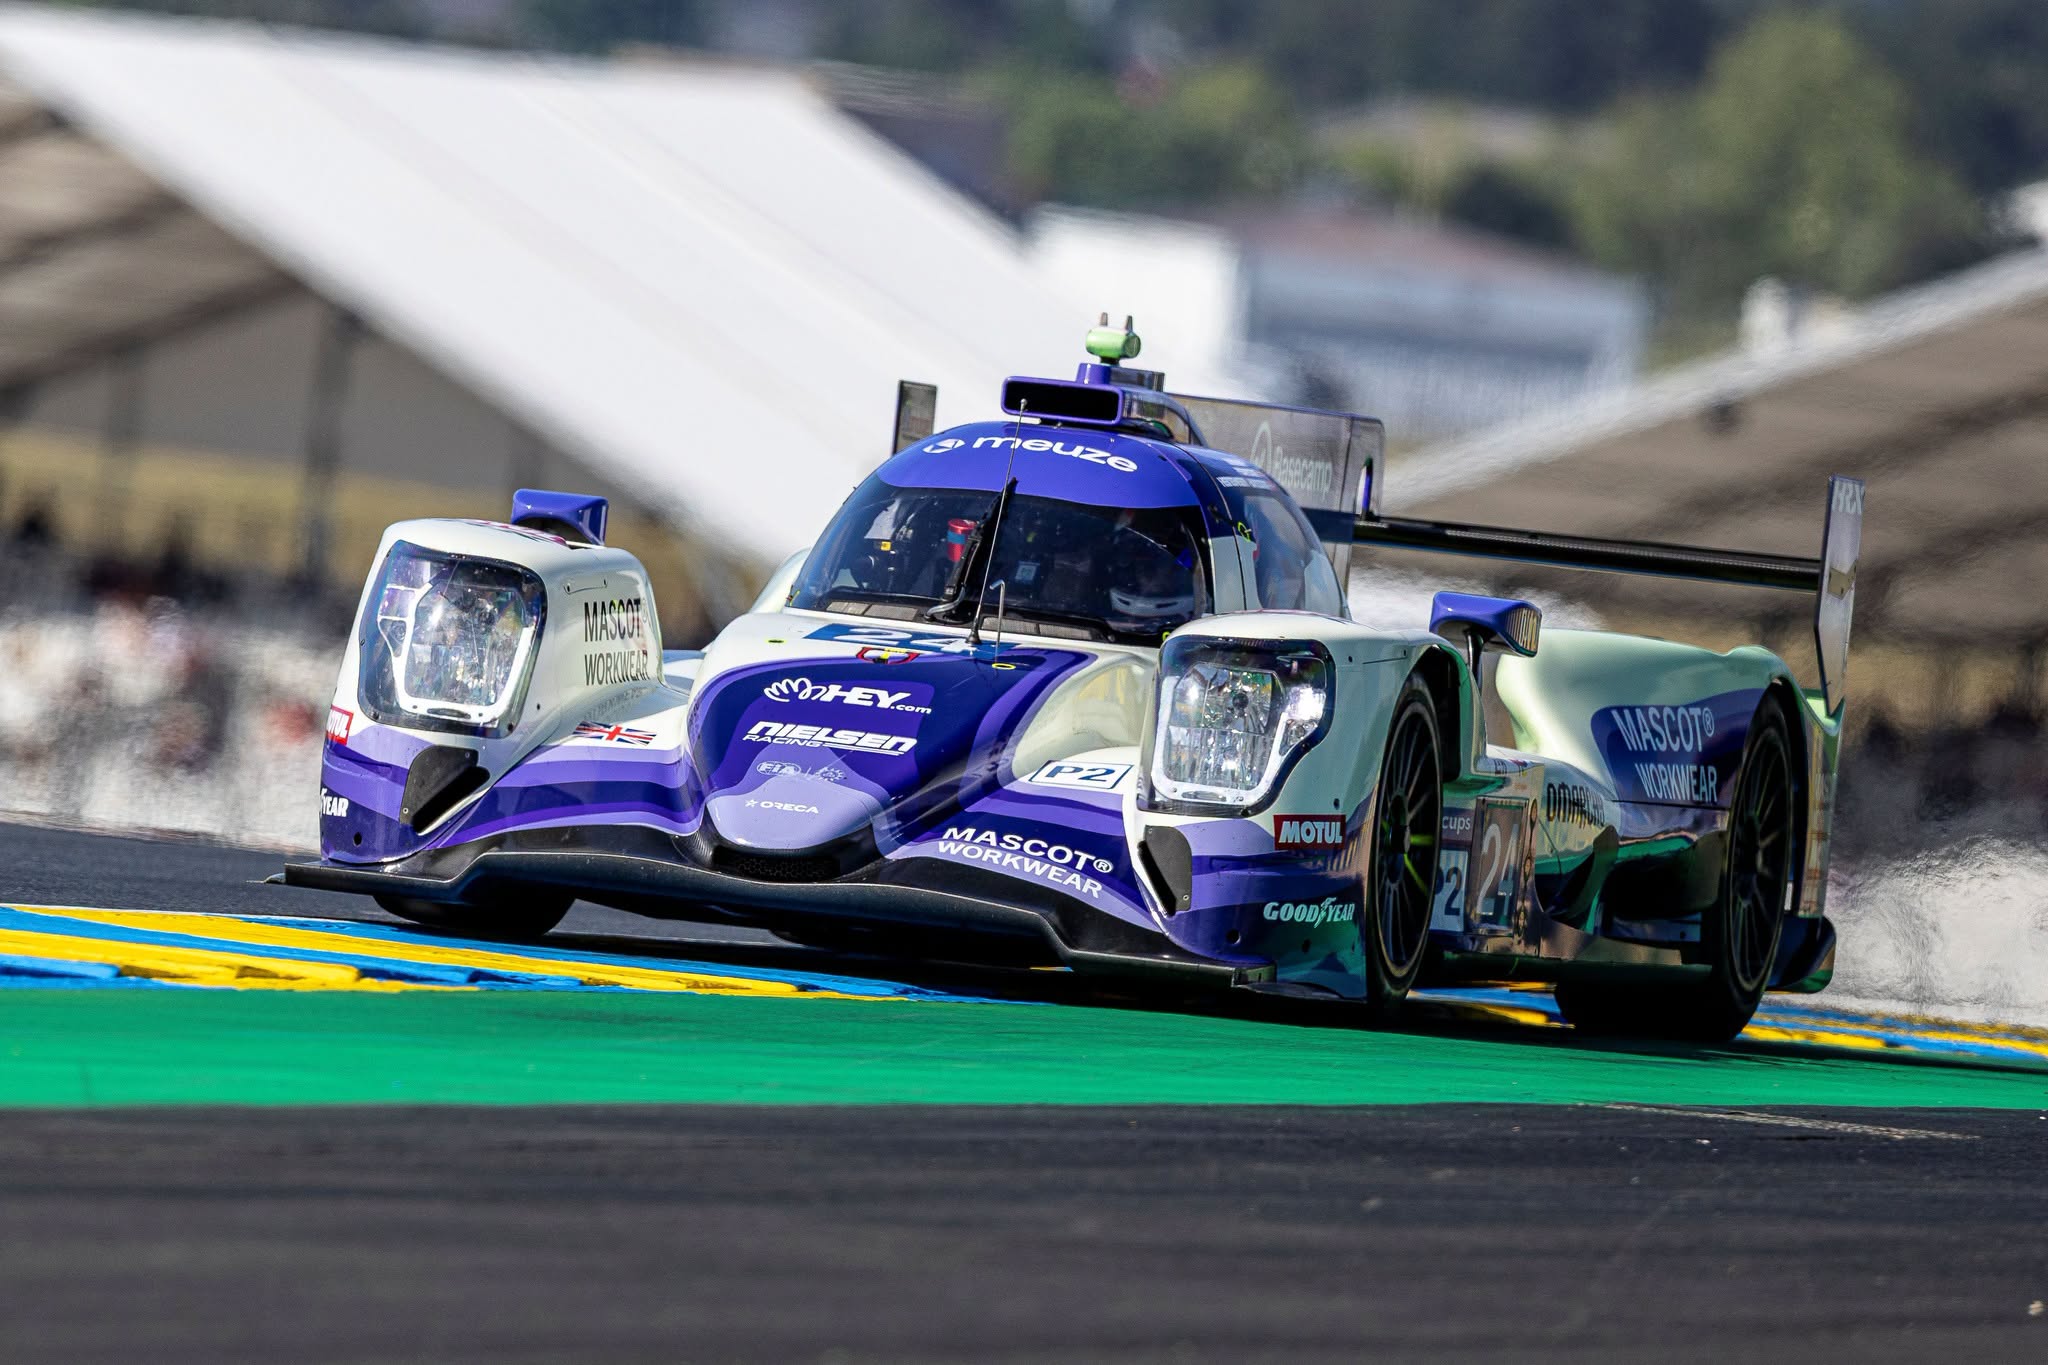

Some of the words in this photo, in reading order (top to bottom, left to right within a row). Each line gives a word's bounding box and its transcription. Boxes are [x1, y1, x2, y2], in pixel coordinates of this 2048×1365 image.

[972, 436, 1138, 472] meuze
[834, 627, 979, 653] 24
[584, 649, 650, 686] WORKWEAR
[743, 735, 823, 748] RACING
[759, 762, 797, 776] FIA
[1045, 765, 1117, 783] P2
[1635, 762, 1718, 803] WORKWEAR
[759, 801, 819, 814] ORECA
[1279, 821, 1343, 844] MOTUL
[938, 841, 1103, 898] WORKWEAR
[1476, 822, 1519, 918] 24
